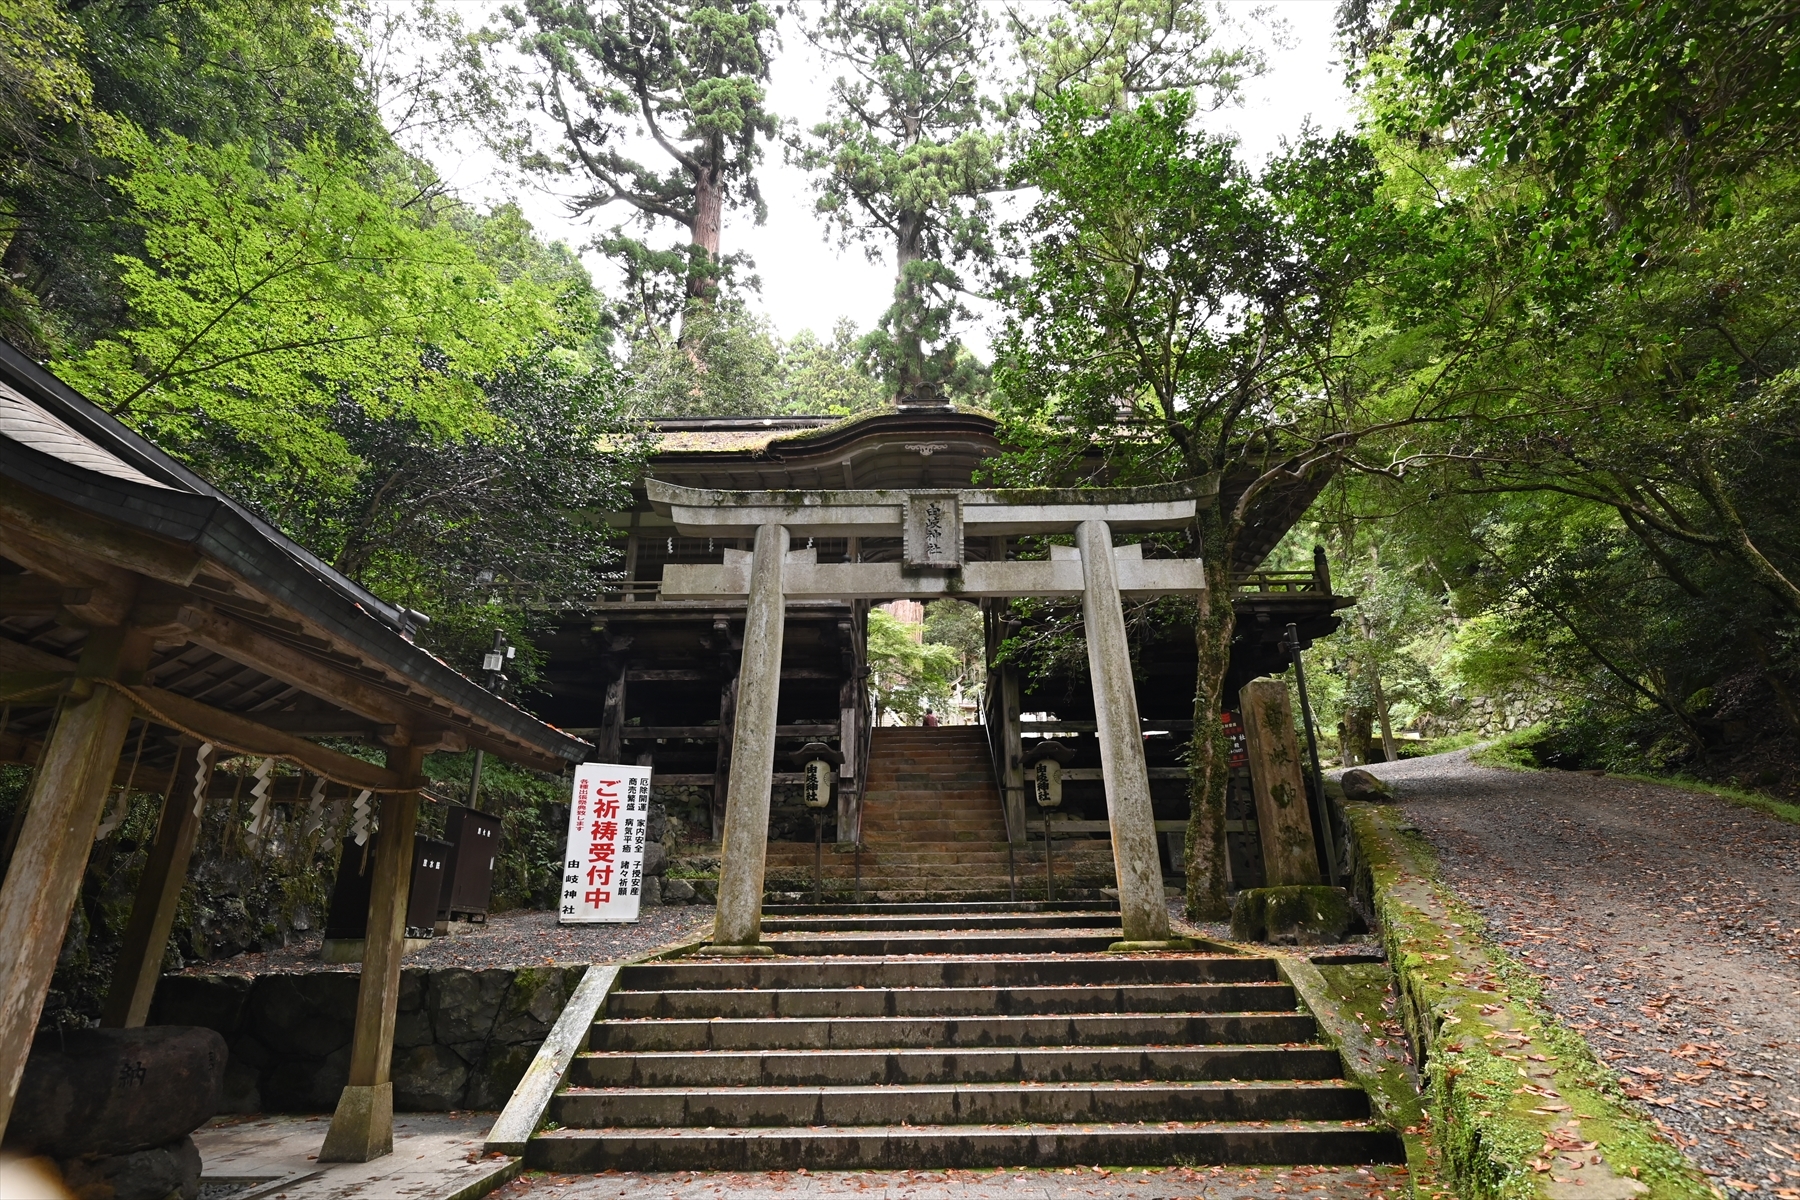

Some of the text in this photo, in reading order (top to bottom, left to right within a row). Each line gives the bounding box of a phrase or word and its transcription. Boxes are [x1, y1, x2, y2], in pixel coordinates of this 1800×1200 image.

[926, 502, 942, 555] 由岐神社
[575, 779, 589, 832] 各種出張祭典致します
[806, 764, 819, 802] 由岐神社
[1036, 763, 1051, 801] 由岐神社
[584, 780, 622, 909] ご祈祷受付中
[617, 777, 638, 896] 商売繁盛 病気平癒 諸々祈願
[629, 777, 649, 896] 厄除開運 家内安全 子授安産
[562, 859, 580, 914] 由岐神社
